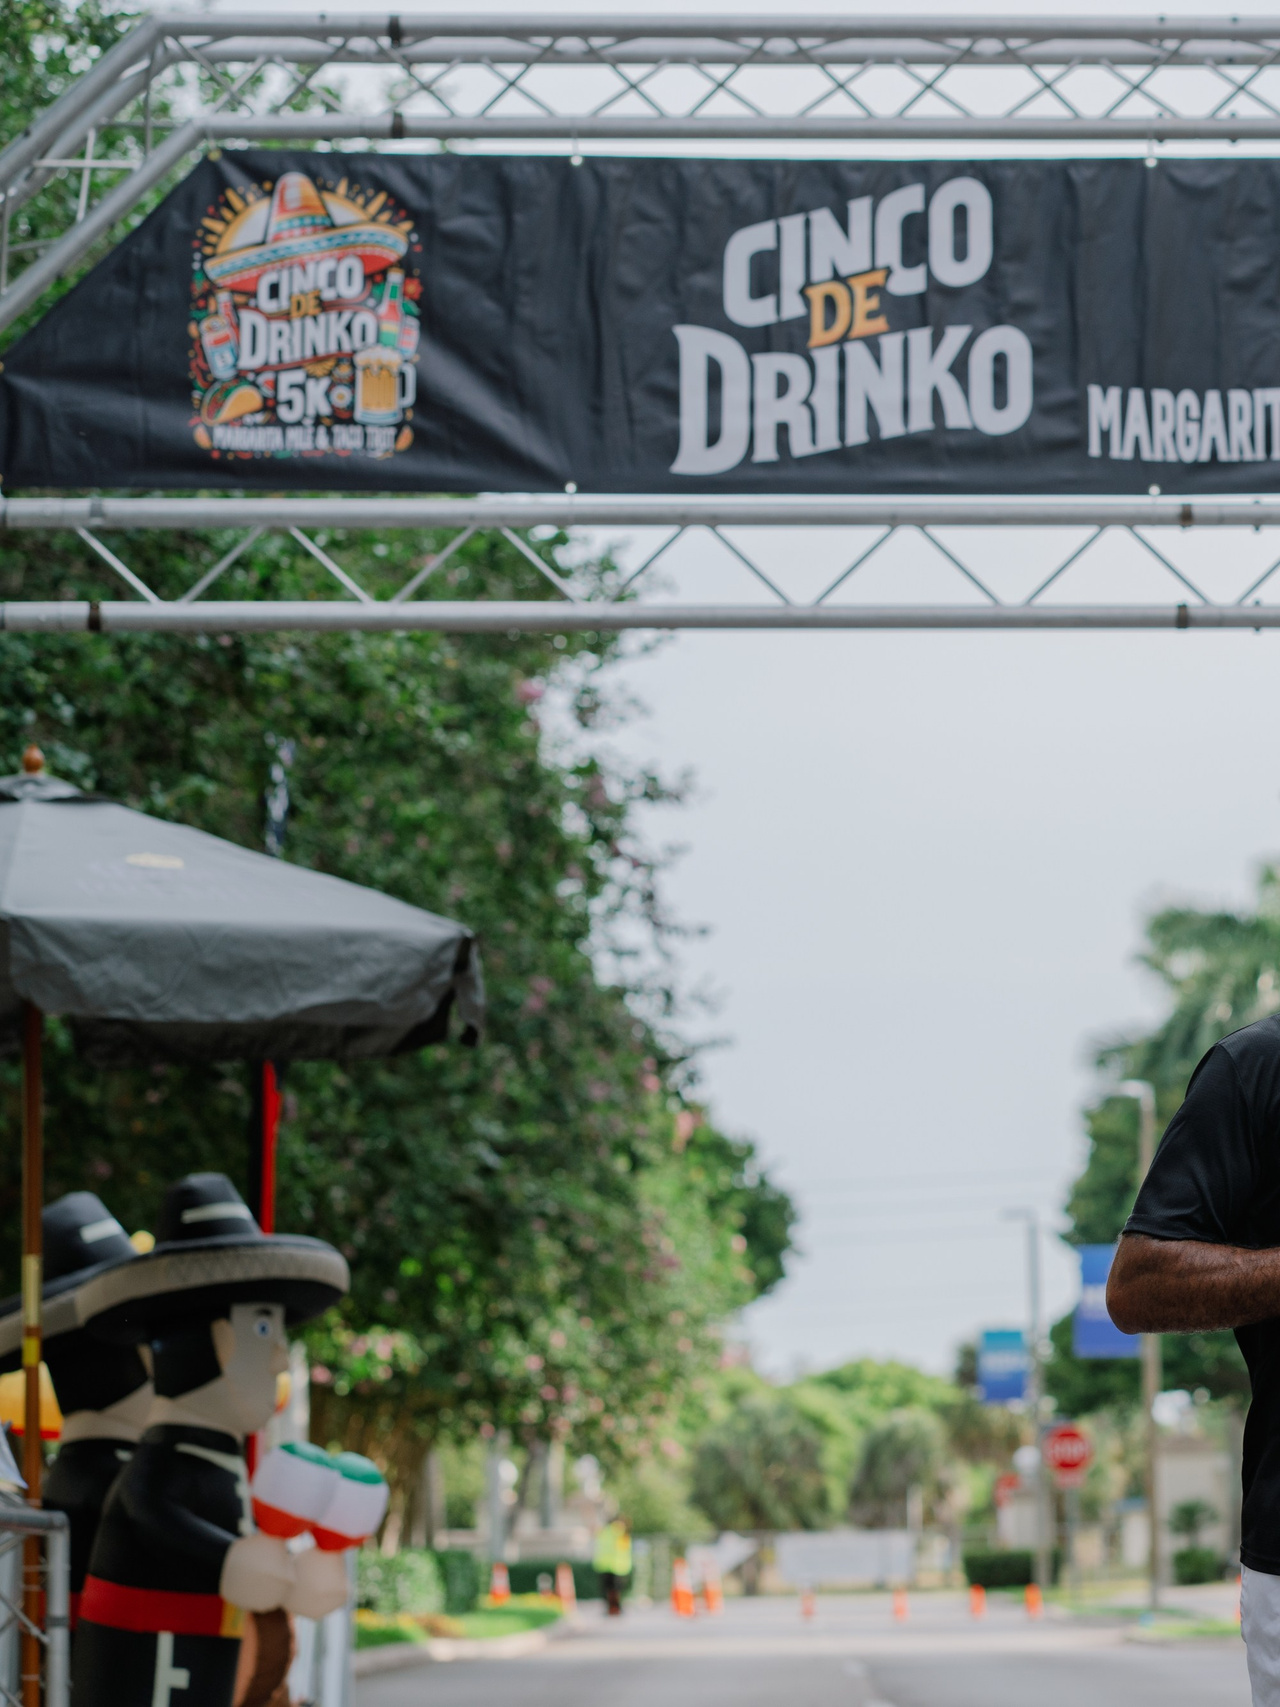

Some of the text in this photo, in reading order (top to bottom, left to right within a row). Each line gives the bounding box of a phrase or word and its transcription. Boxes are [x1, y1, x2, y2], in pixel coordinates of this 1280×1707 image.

[723, 176, 993, 328] CINCO
[257, 255, 364, 312] CINCO
[291, 290, 322, 319] DE
[804, 268, 890, 349] DE
[238, 310, 377, 369] DRINKO
[276, 368, 332, 424] 5K
[669, 324, 1034, 475] DRINKO
